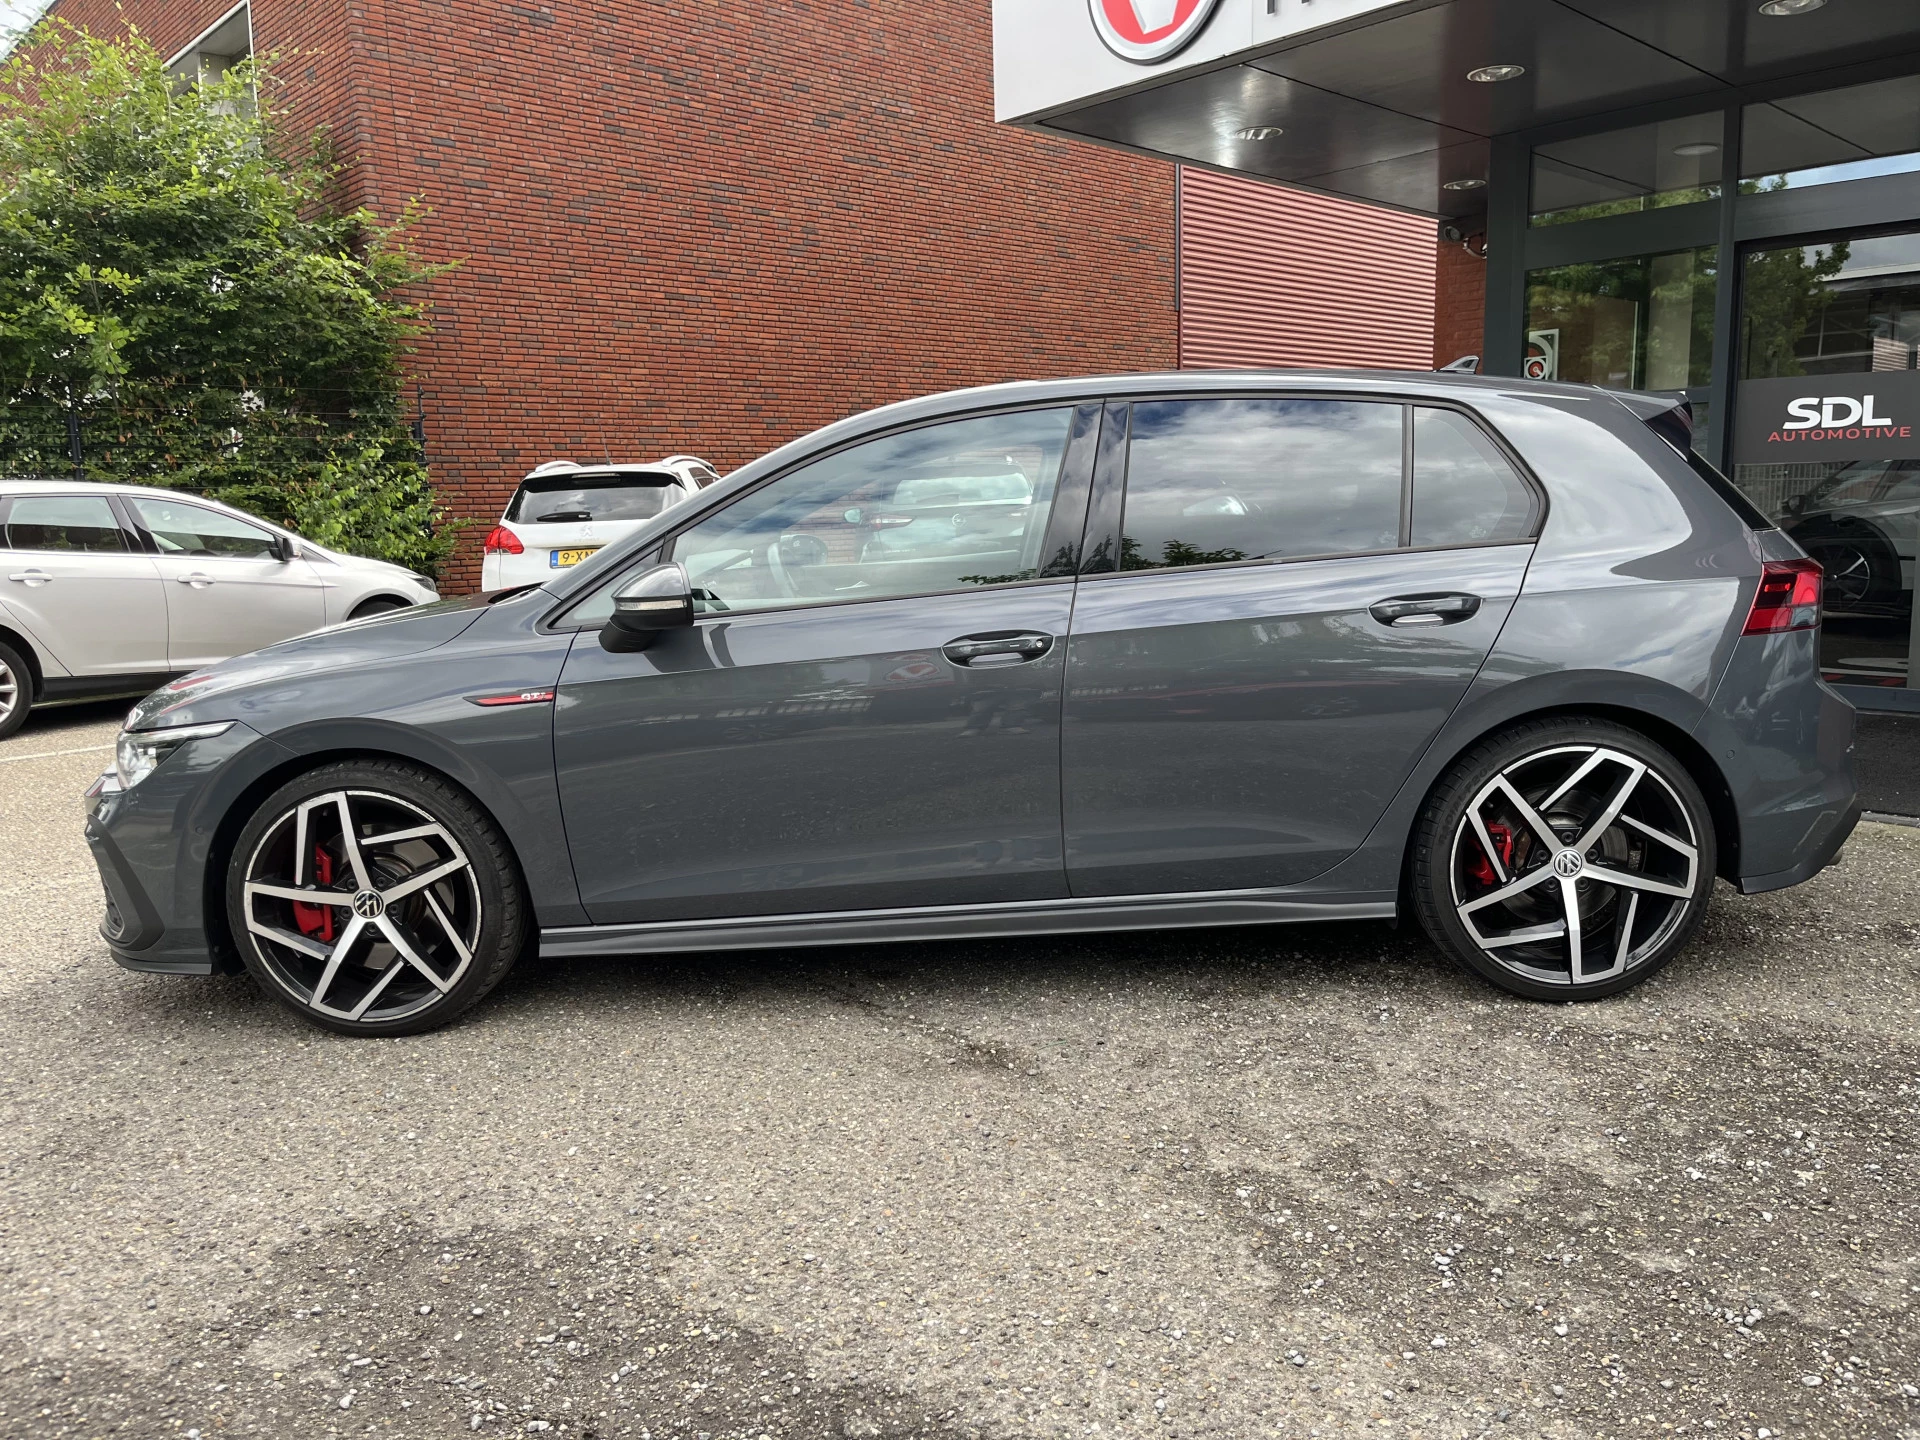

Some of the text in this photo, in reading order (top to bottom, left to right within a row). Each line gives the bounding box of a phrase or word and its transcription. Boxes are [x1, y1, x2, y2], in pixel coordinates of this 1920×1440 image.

[1782, 395, 1893, 429] SDL
[1767, 426, 1912, 442] AUTOMOTIVE
[521, 692, 546, 701] GTI
